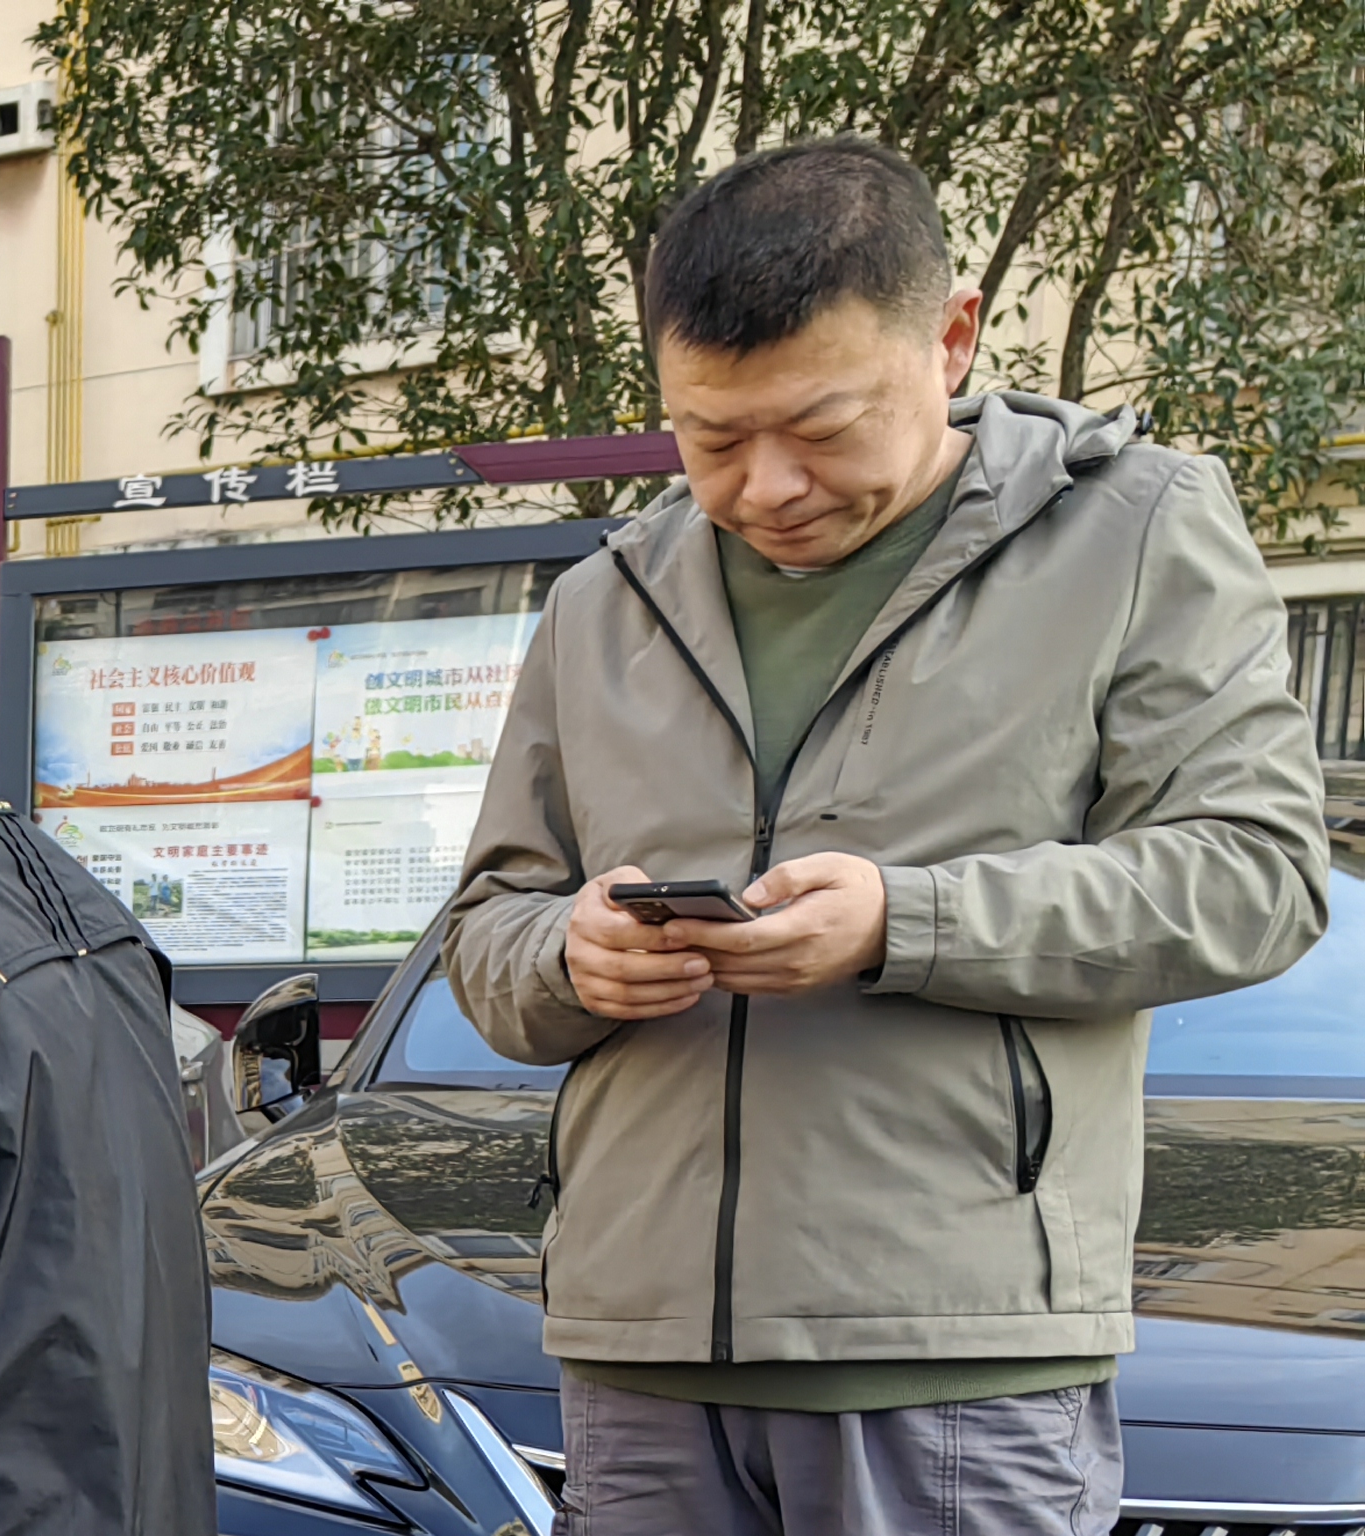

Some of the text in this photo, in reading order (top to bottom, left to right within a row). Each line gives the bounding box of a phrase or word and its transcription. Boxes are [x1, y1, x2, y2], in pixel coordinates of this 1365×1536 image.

[113, 461, 340, 508] 宣传栏
[89, 661, 257, 690] 社会主义核心价值观
[364, 690, 513, 716] 做文明市民从点
